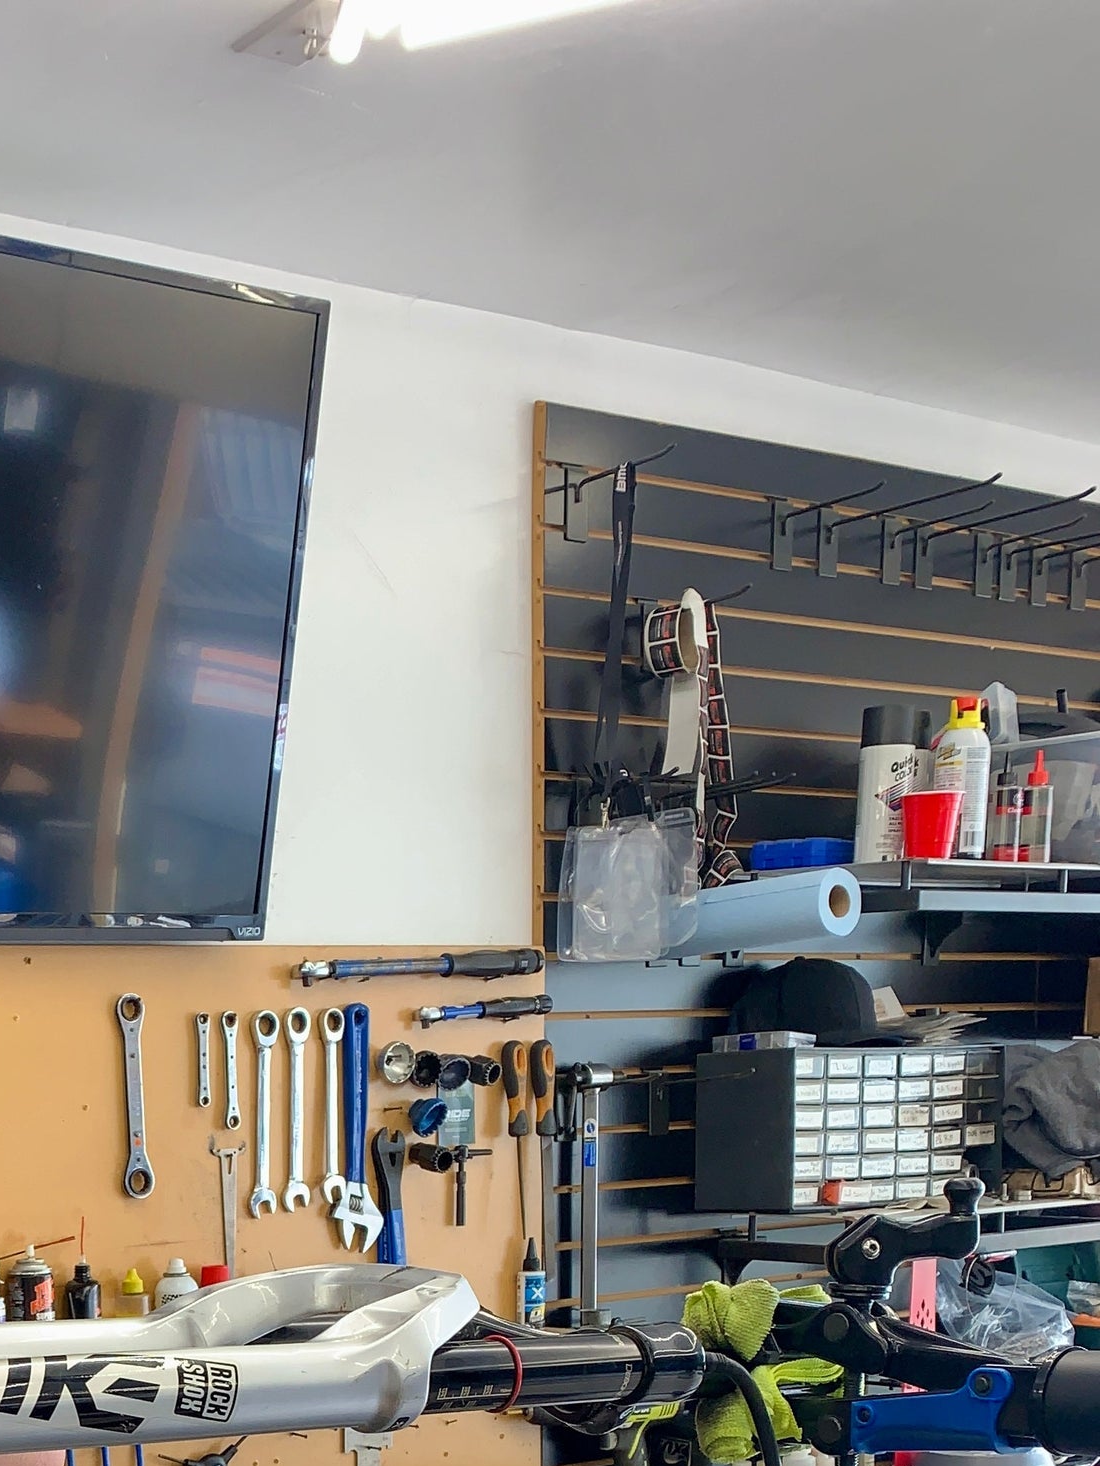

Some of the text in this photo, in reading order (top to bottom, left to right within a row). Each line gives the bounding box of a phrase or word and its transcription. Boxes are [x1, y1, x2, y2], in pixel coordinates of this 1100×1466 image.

[237, 926, 261, 936] VIZIO
[180, 1360, 205, 1412] SHOX
[206, 1367, 233, 1416] ROCK
